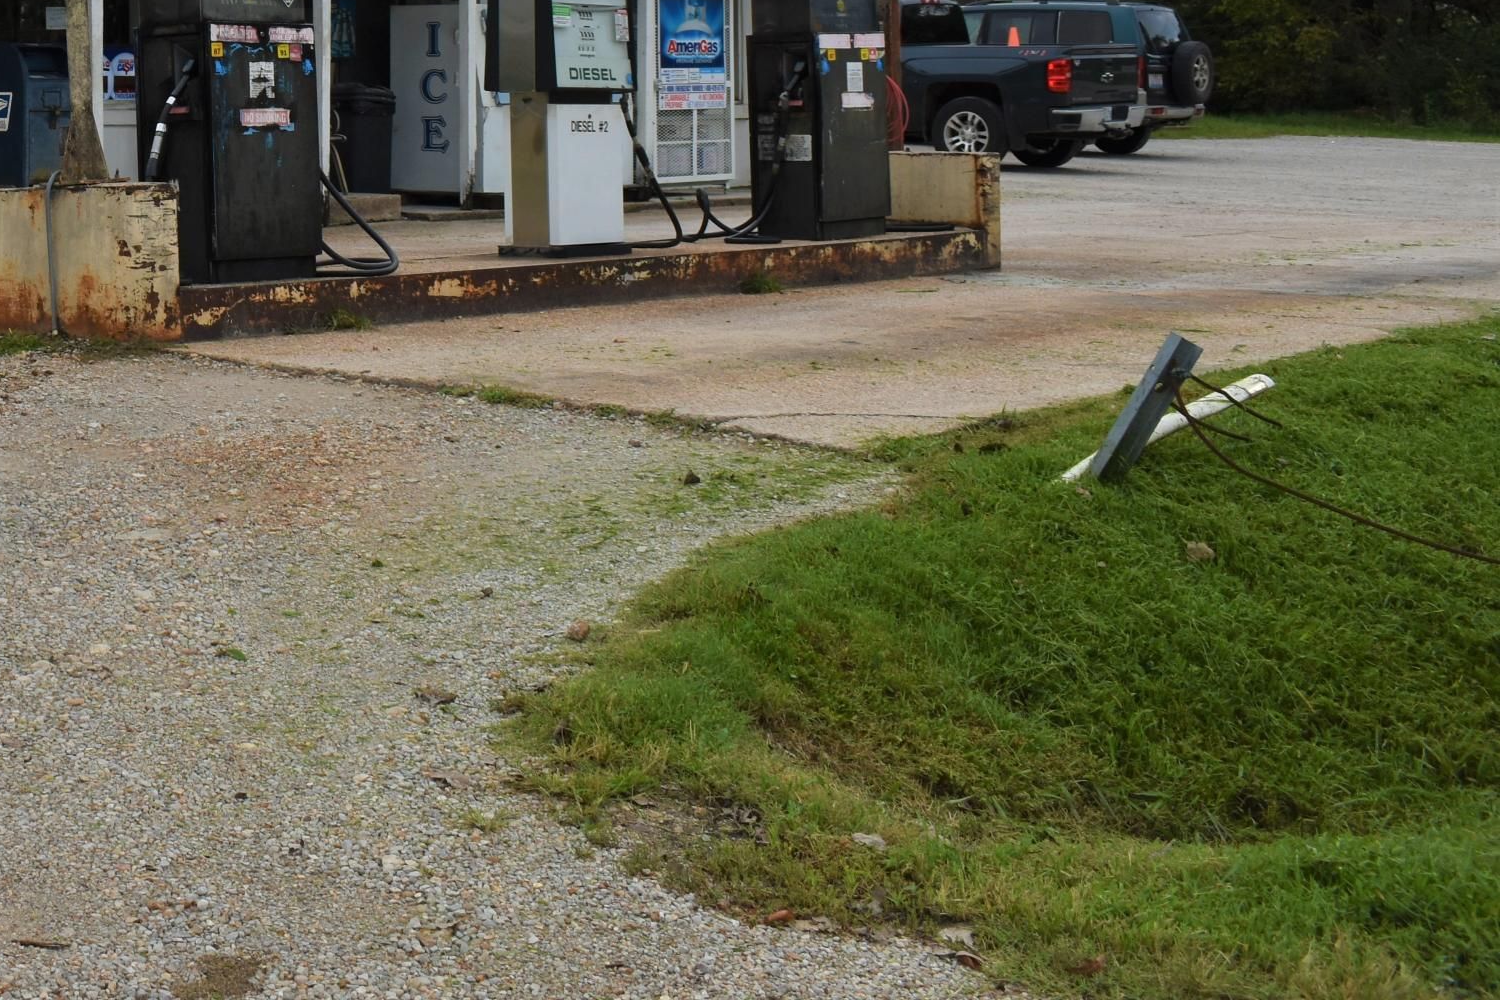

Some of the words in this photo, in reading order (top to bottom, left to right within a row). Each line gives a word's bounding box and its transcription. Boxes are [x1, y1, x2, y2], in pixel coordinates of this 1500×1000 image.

[668, 40, 718, 53] AmeriGas
[569, 66, 617, 81] DIESEL
[255, 112, 287, 123] SMOKING
[571, 120, 596, 132] DIESEL
[599, 120, 609, 132] #2
